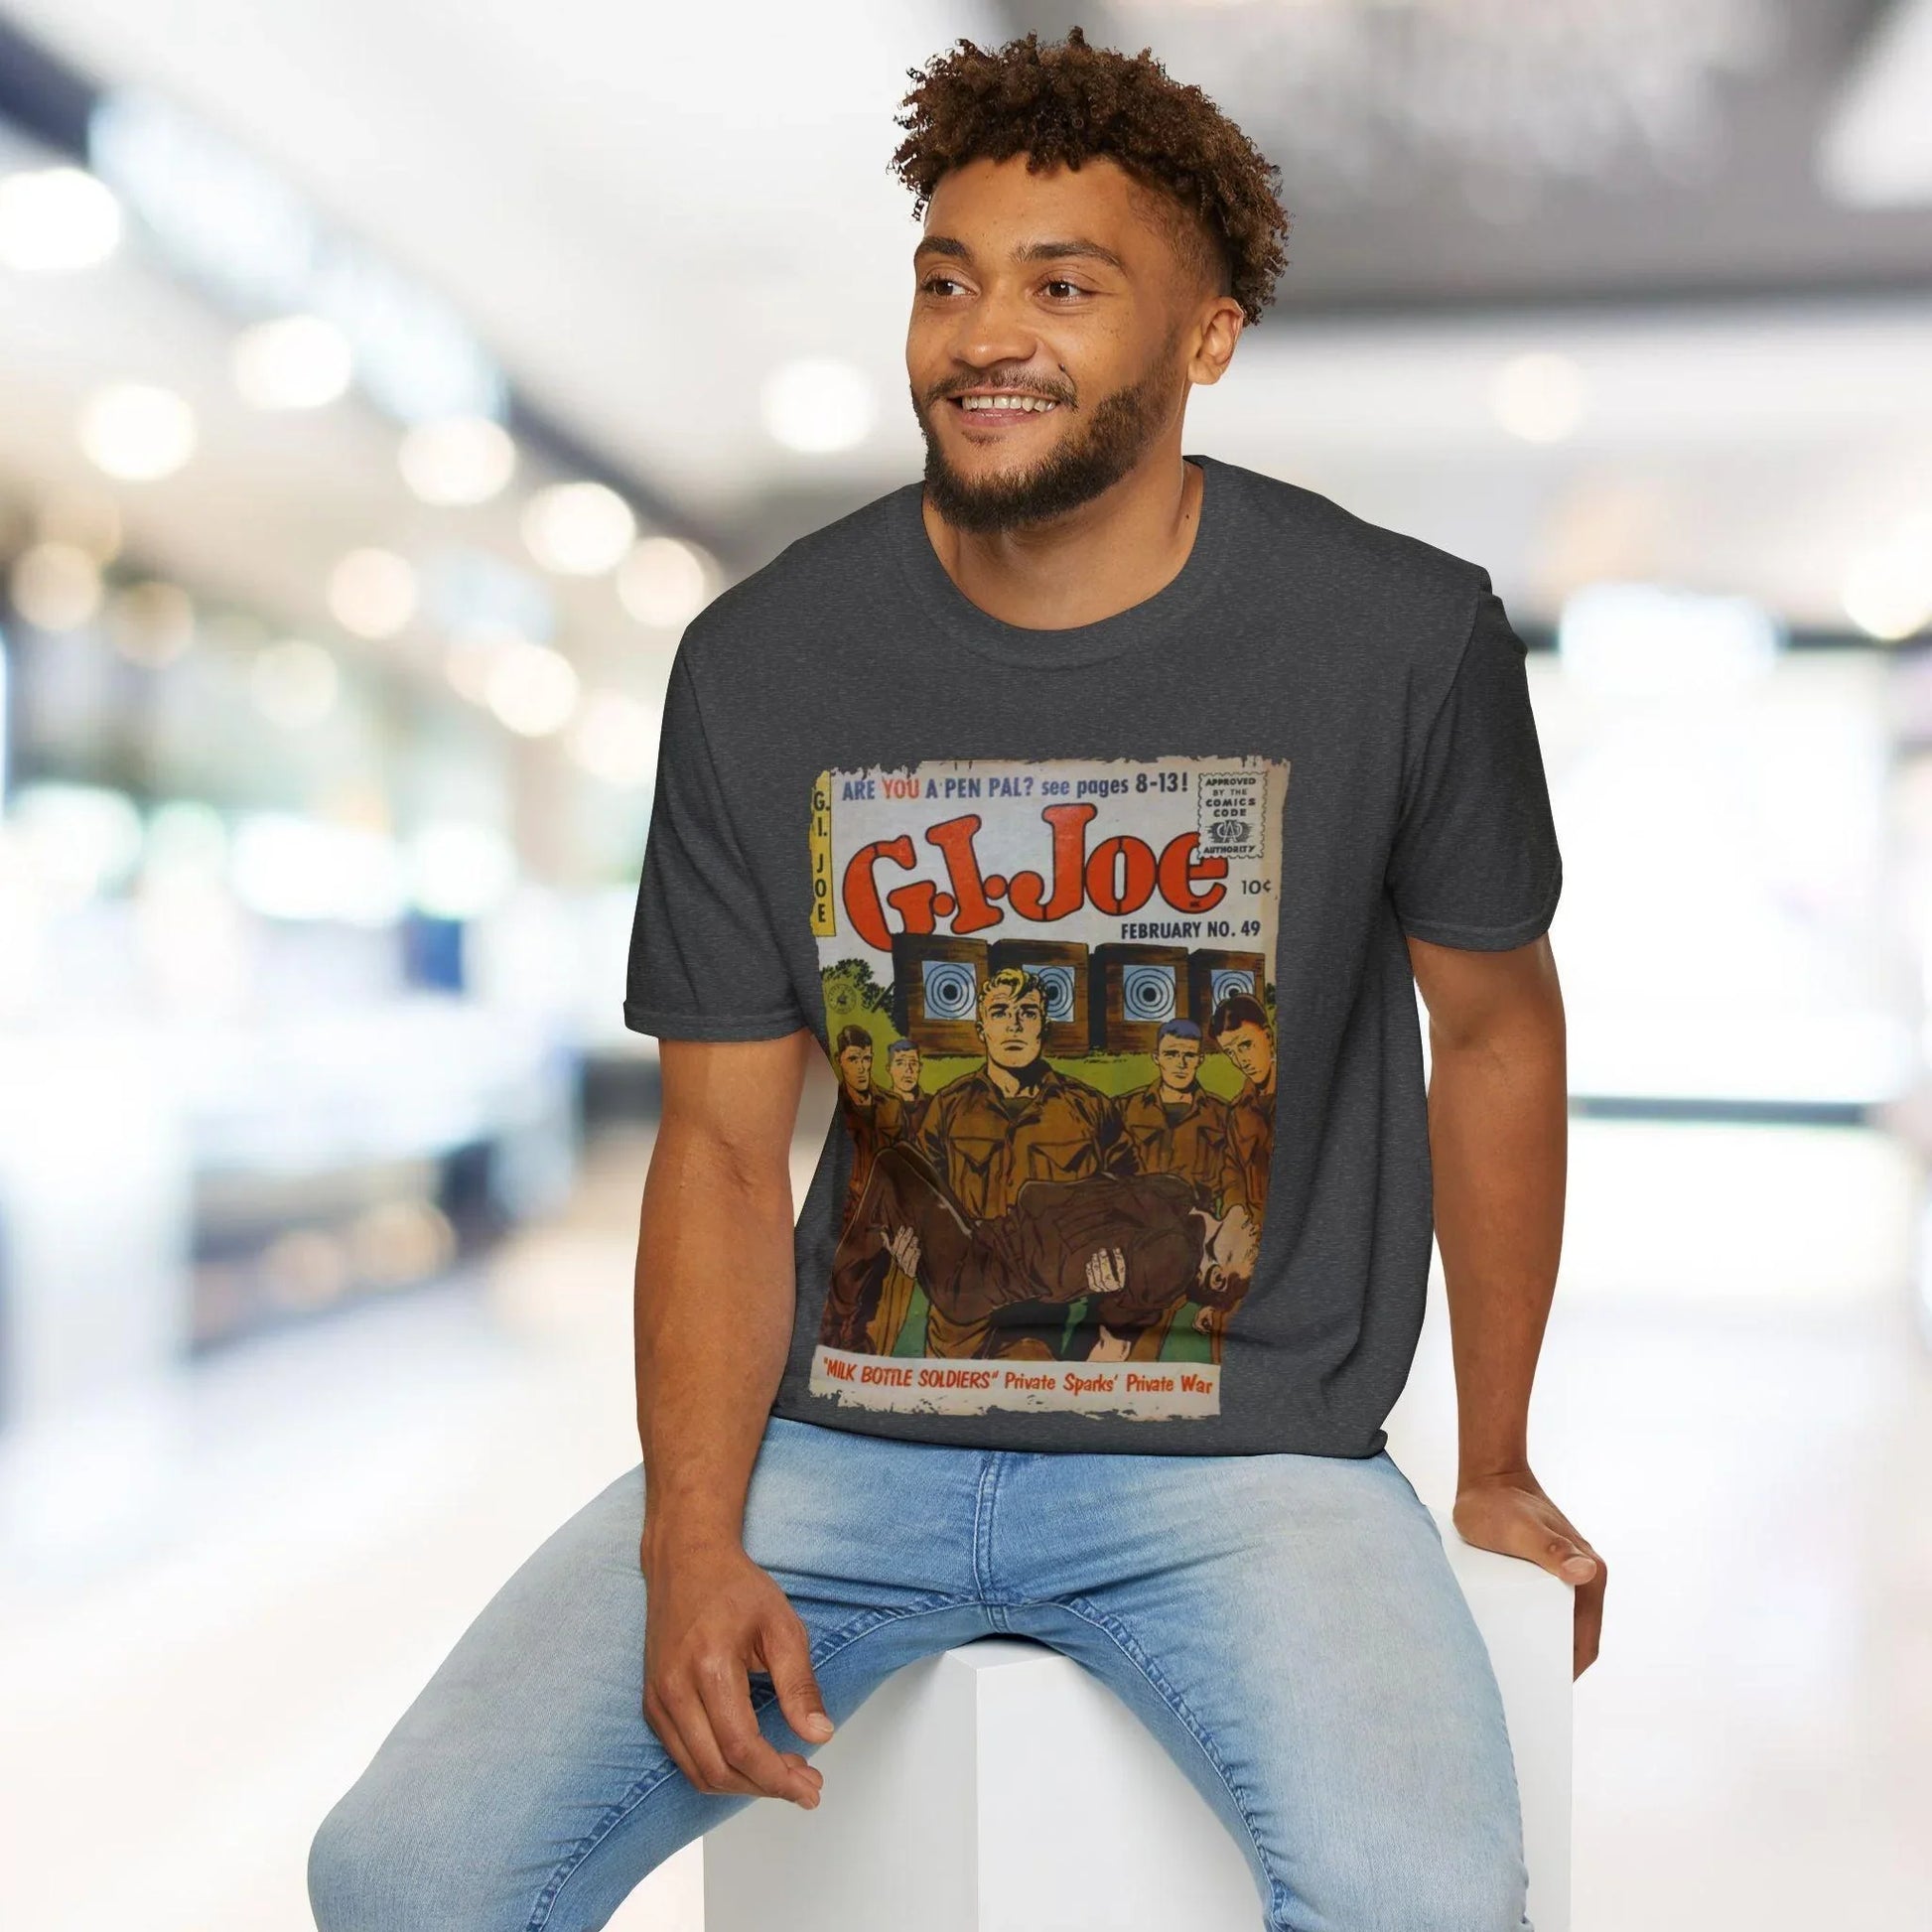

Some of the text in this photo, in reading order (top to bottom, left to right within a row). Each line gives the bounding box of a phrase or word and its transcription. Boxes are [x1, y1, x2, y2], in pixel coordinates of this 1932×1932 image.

[842, 771, 1188, 801] ARE YOU A PEN PAL? see pages 8-13!
[1205, 777, 1257, 786] APPROVED
[1212, 788, 1225, 797] BY
[1205, 797, 1256, 807] COMICS
[1213, 808, 1247, 817] CODE
[1203, 845, 1256, 854] AUTHORITY
[1241, 879, 1272, 895] 10¢
[1121, 920, 1261, 939] FEBRUARY NO. 49
[823, 1356, 1213, 1396] "MILK BOTTLE SOLDIERS" Private Sparks' Private War
